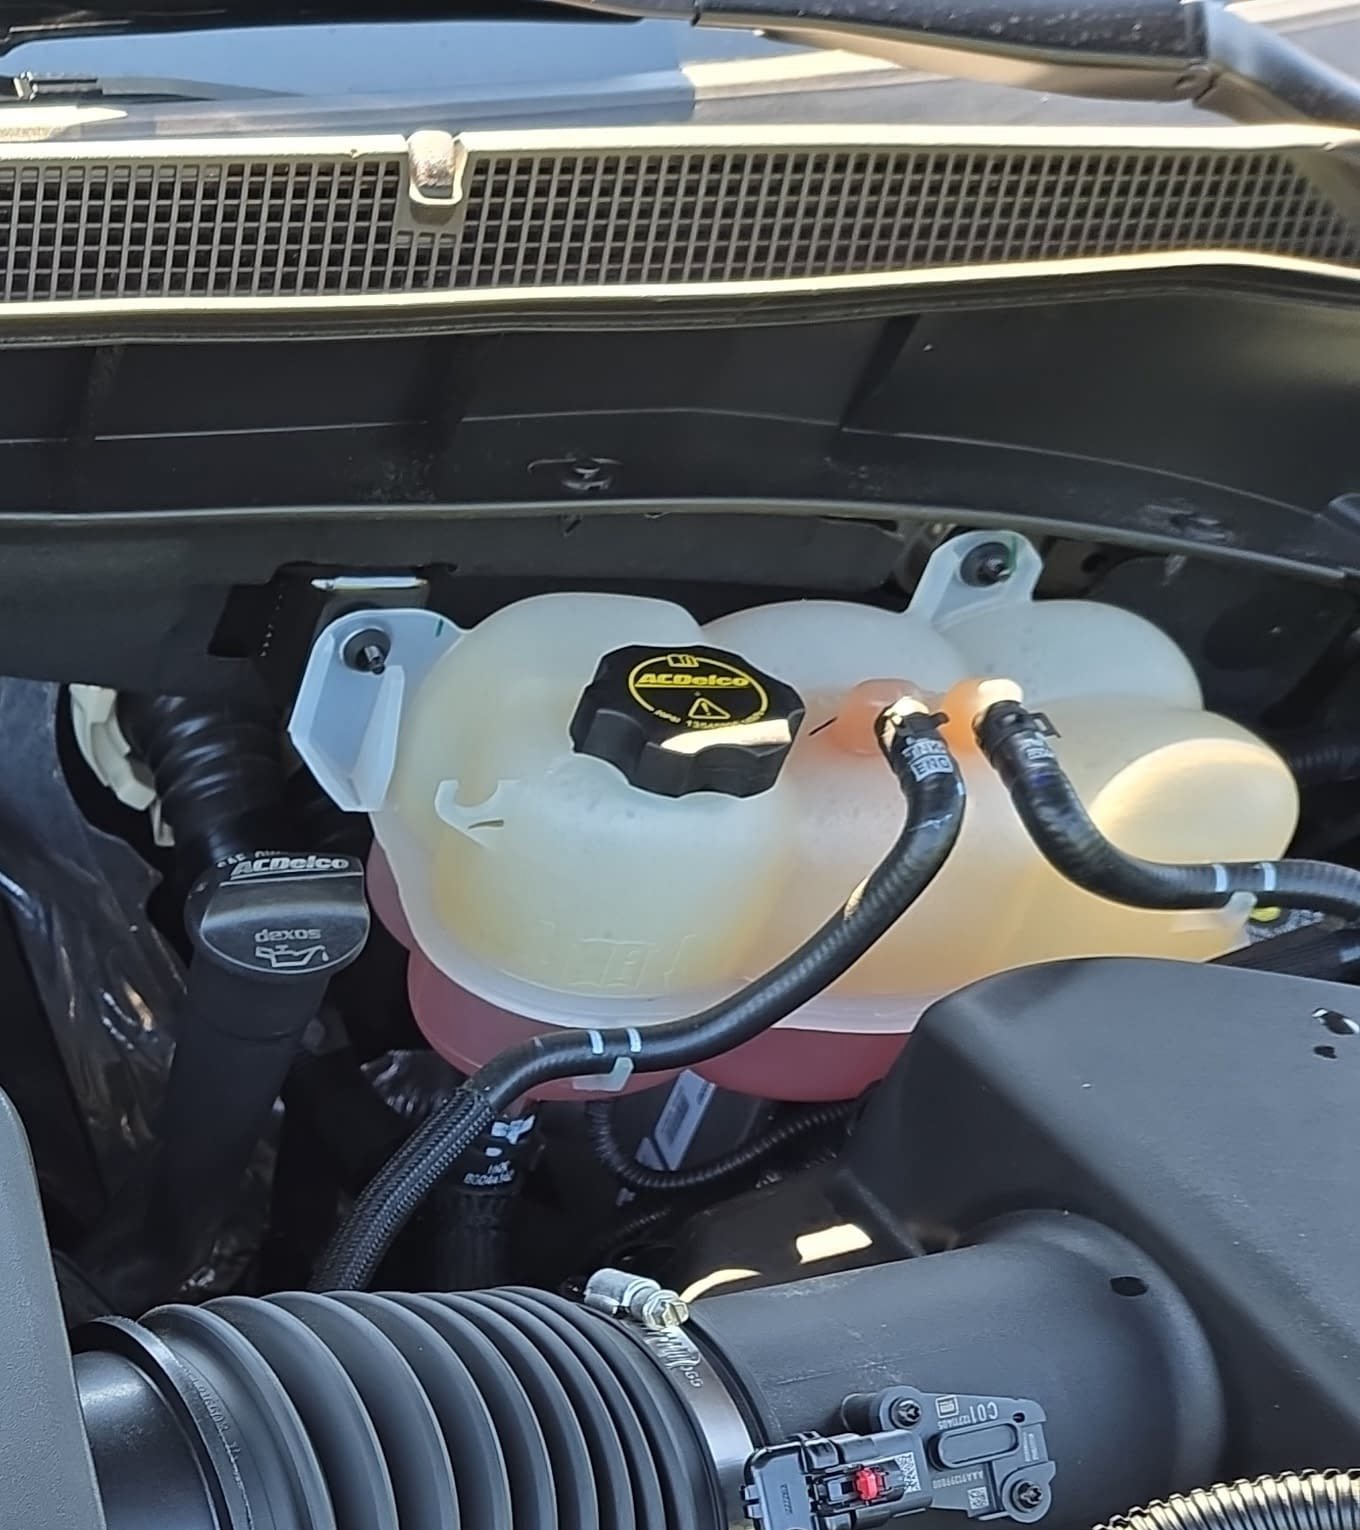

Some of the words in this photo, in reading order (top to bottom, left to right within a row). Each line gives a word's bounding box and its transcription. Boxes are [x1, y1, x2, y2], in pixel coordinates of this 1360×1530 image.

[635, 672, 752, 687] ACDelco
[230, 855, 350, 876] ACDelco
[254, 928, 322, 943] dexos
